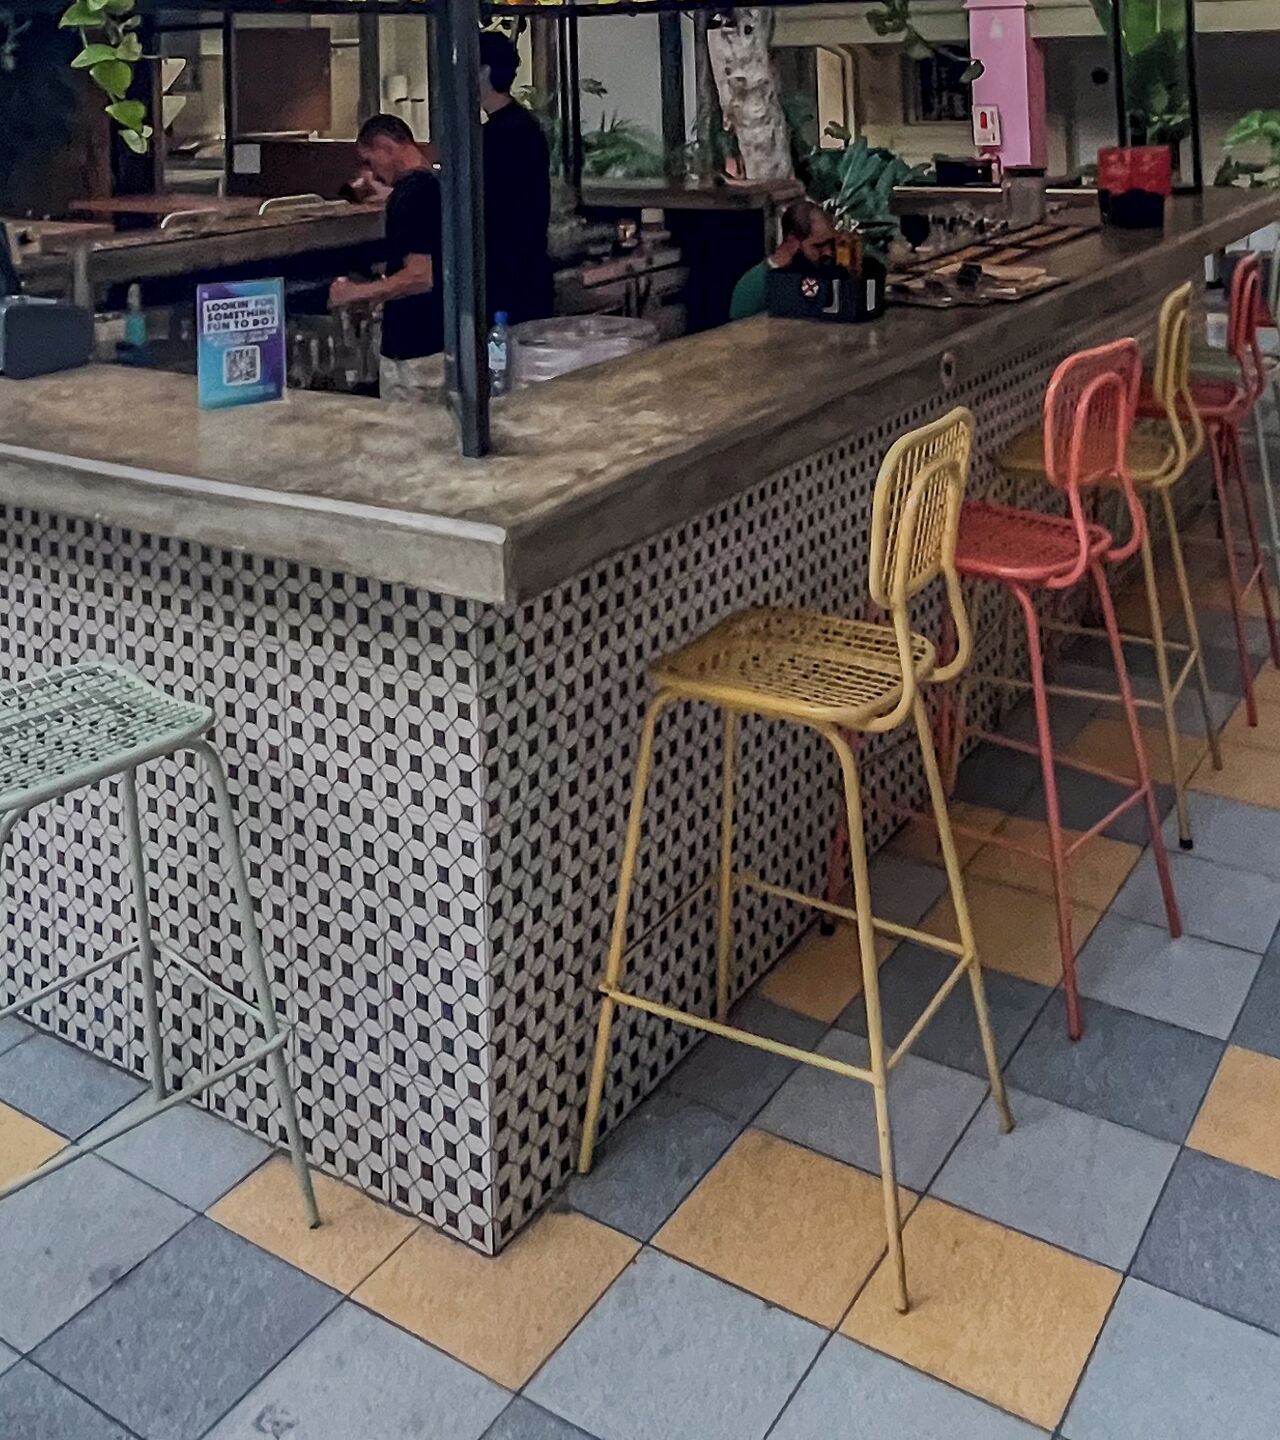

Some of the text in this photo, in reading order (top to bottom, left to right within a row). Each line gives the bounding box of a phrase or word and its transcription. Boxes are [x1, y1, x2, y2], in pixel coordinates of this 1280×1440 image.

[207, 308, 276, 321] SOMETHING
[207, 321, 230, 332] FUN
[234, 319, 250, 329] TO
